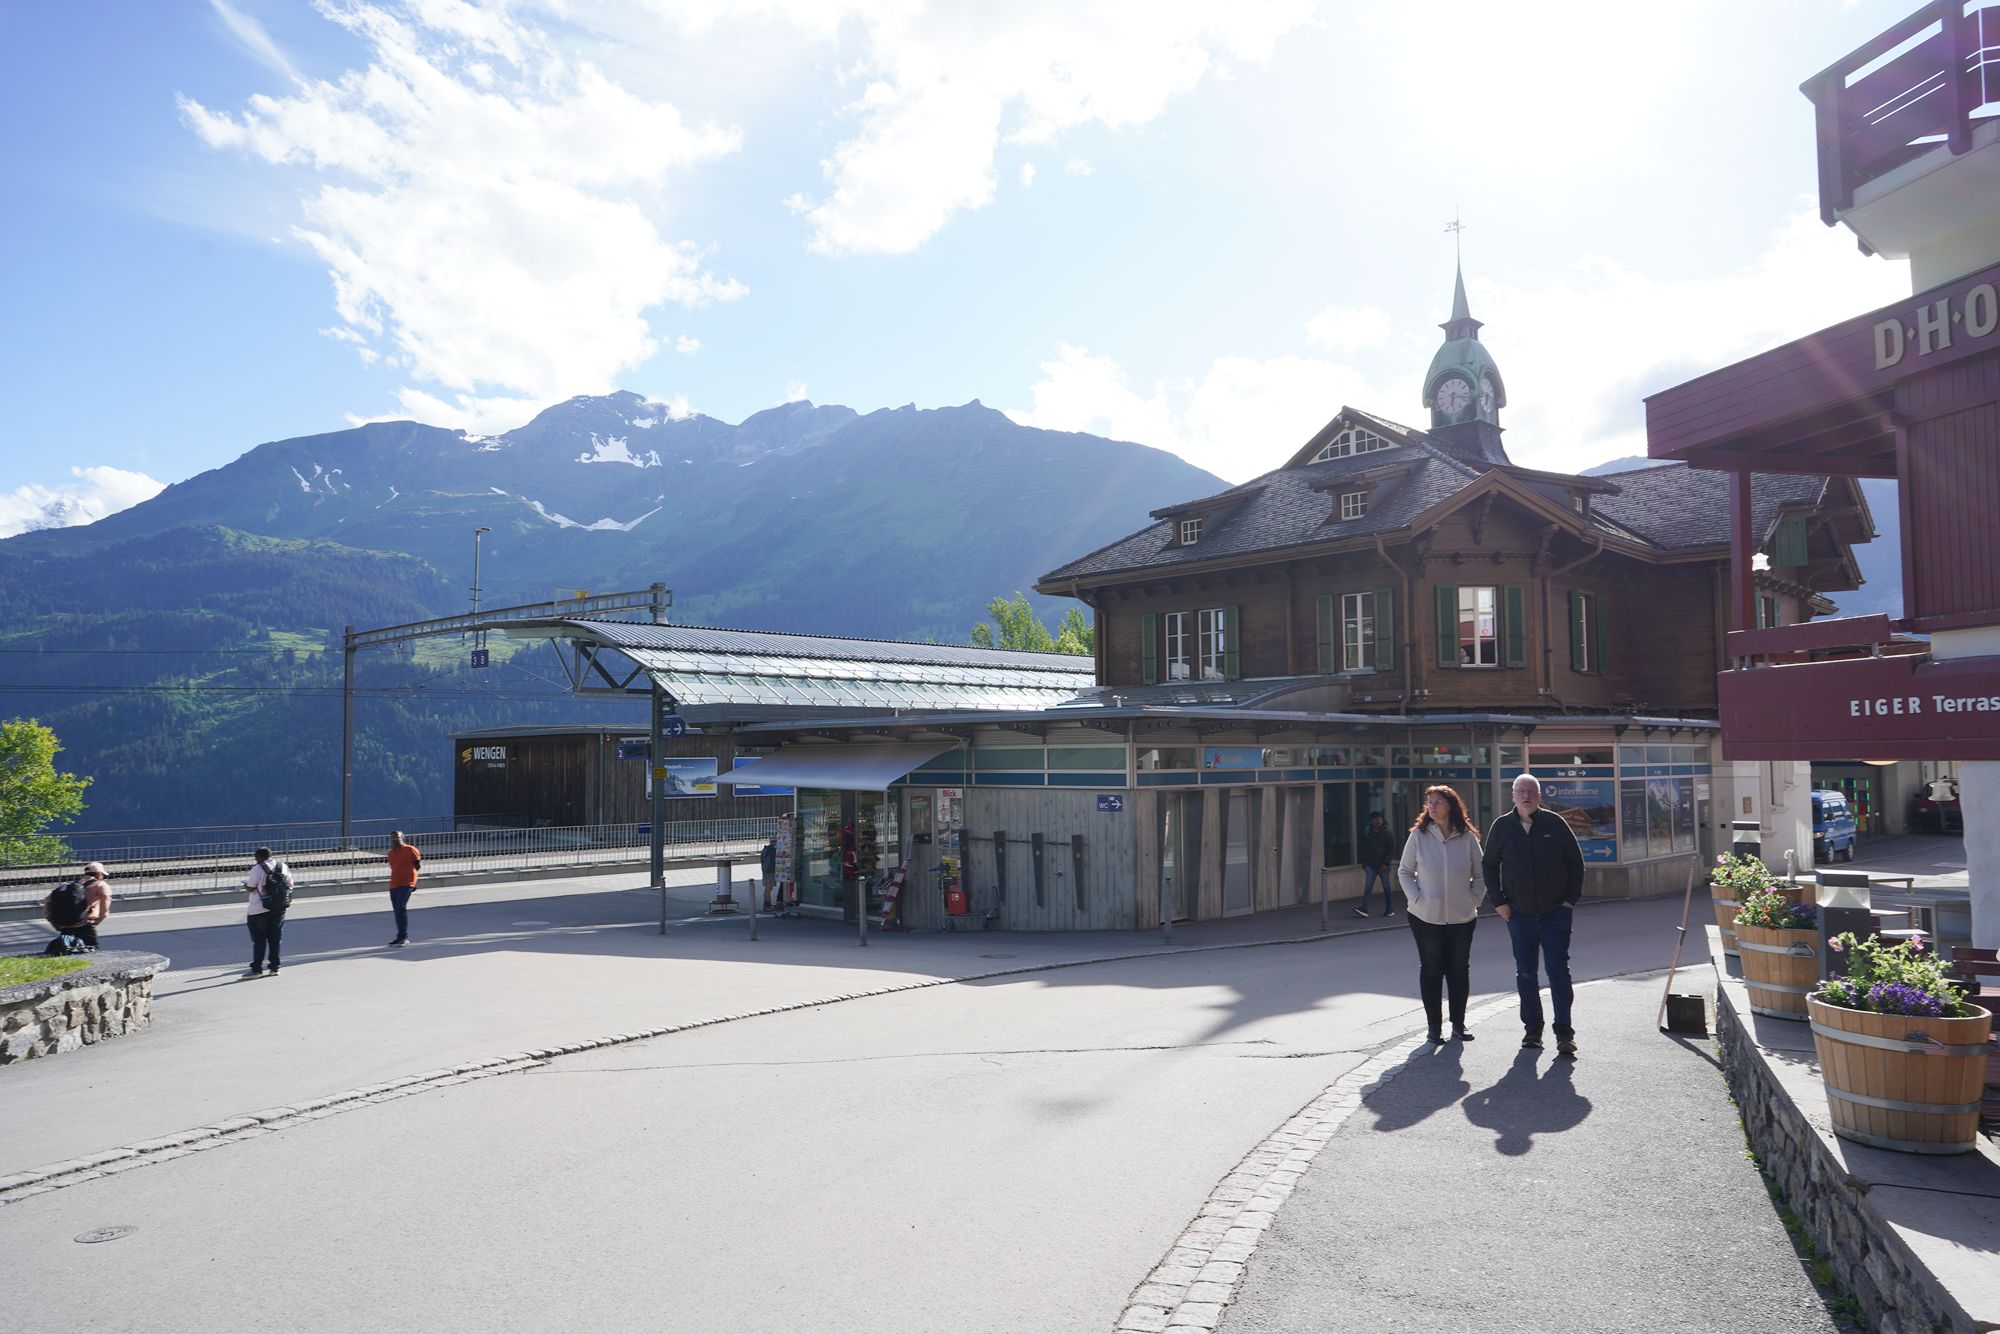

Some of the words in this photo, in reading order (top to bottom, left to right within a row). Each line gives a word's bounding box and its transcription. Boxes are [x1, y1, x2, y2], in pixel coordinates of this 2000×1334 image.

[1850, 696, 1921, 717] EIGER
[1932, 695, 2000, 713] Terras
[662, 727, 671, 736] WC
[473, 746, 506, 760] WENGEN
[617, 749, 623, 758] 2
[943, 789, 957, 797] Blick
[1557, 786, 1600, 796] interhome
